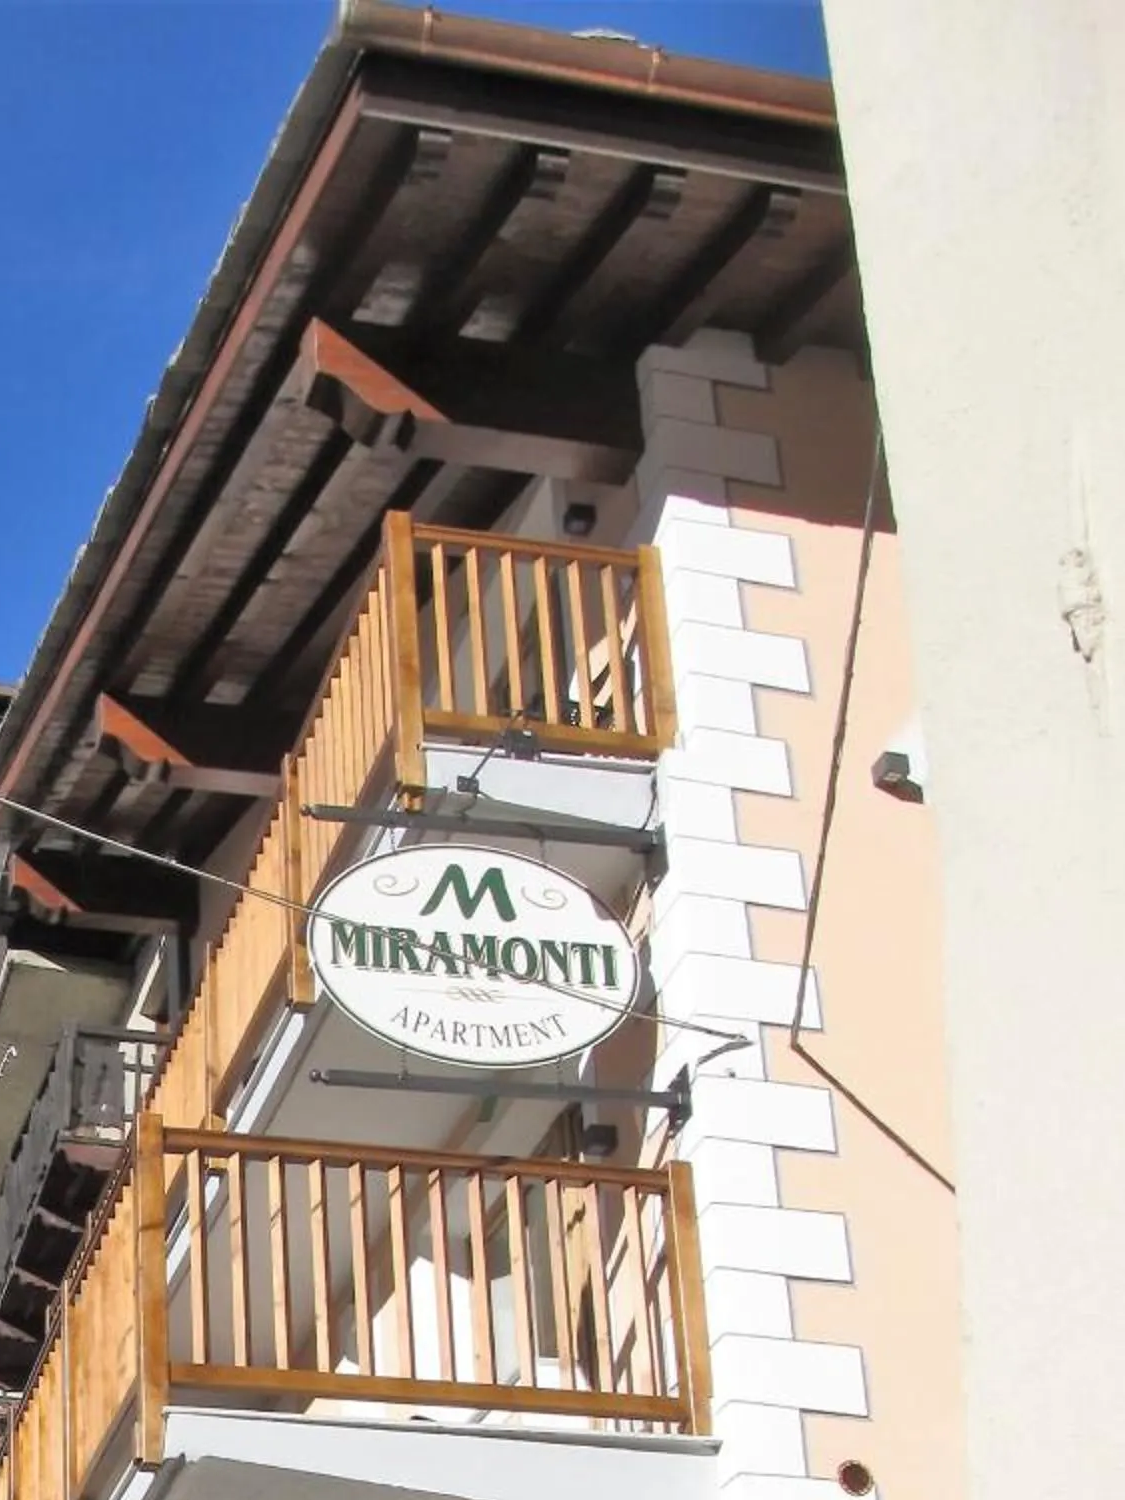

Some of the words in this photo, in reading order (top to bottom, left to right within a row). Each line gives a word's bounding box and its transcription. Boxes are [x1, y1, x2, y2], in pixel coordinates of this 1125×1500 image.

[420, 863, 517, 922] M
[330, 920, 620, 990] MIRAMONTI
[390, 1004, 570, 1050] APARTMENT
